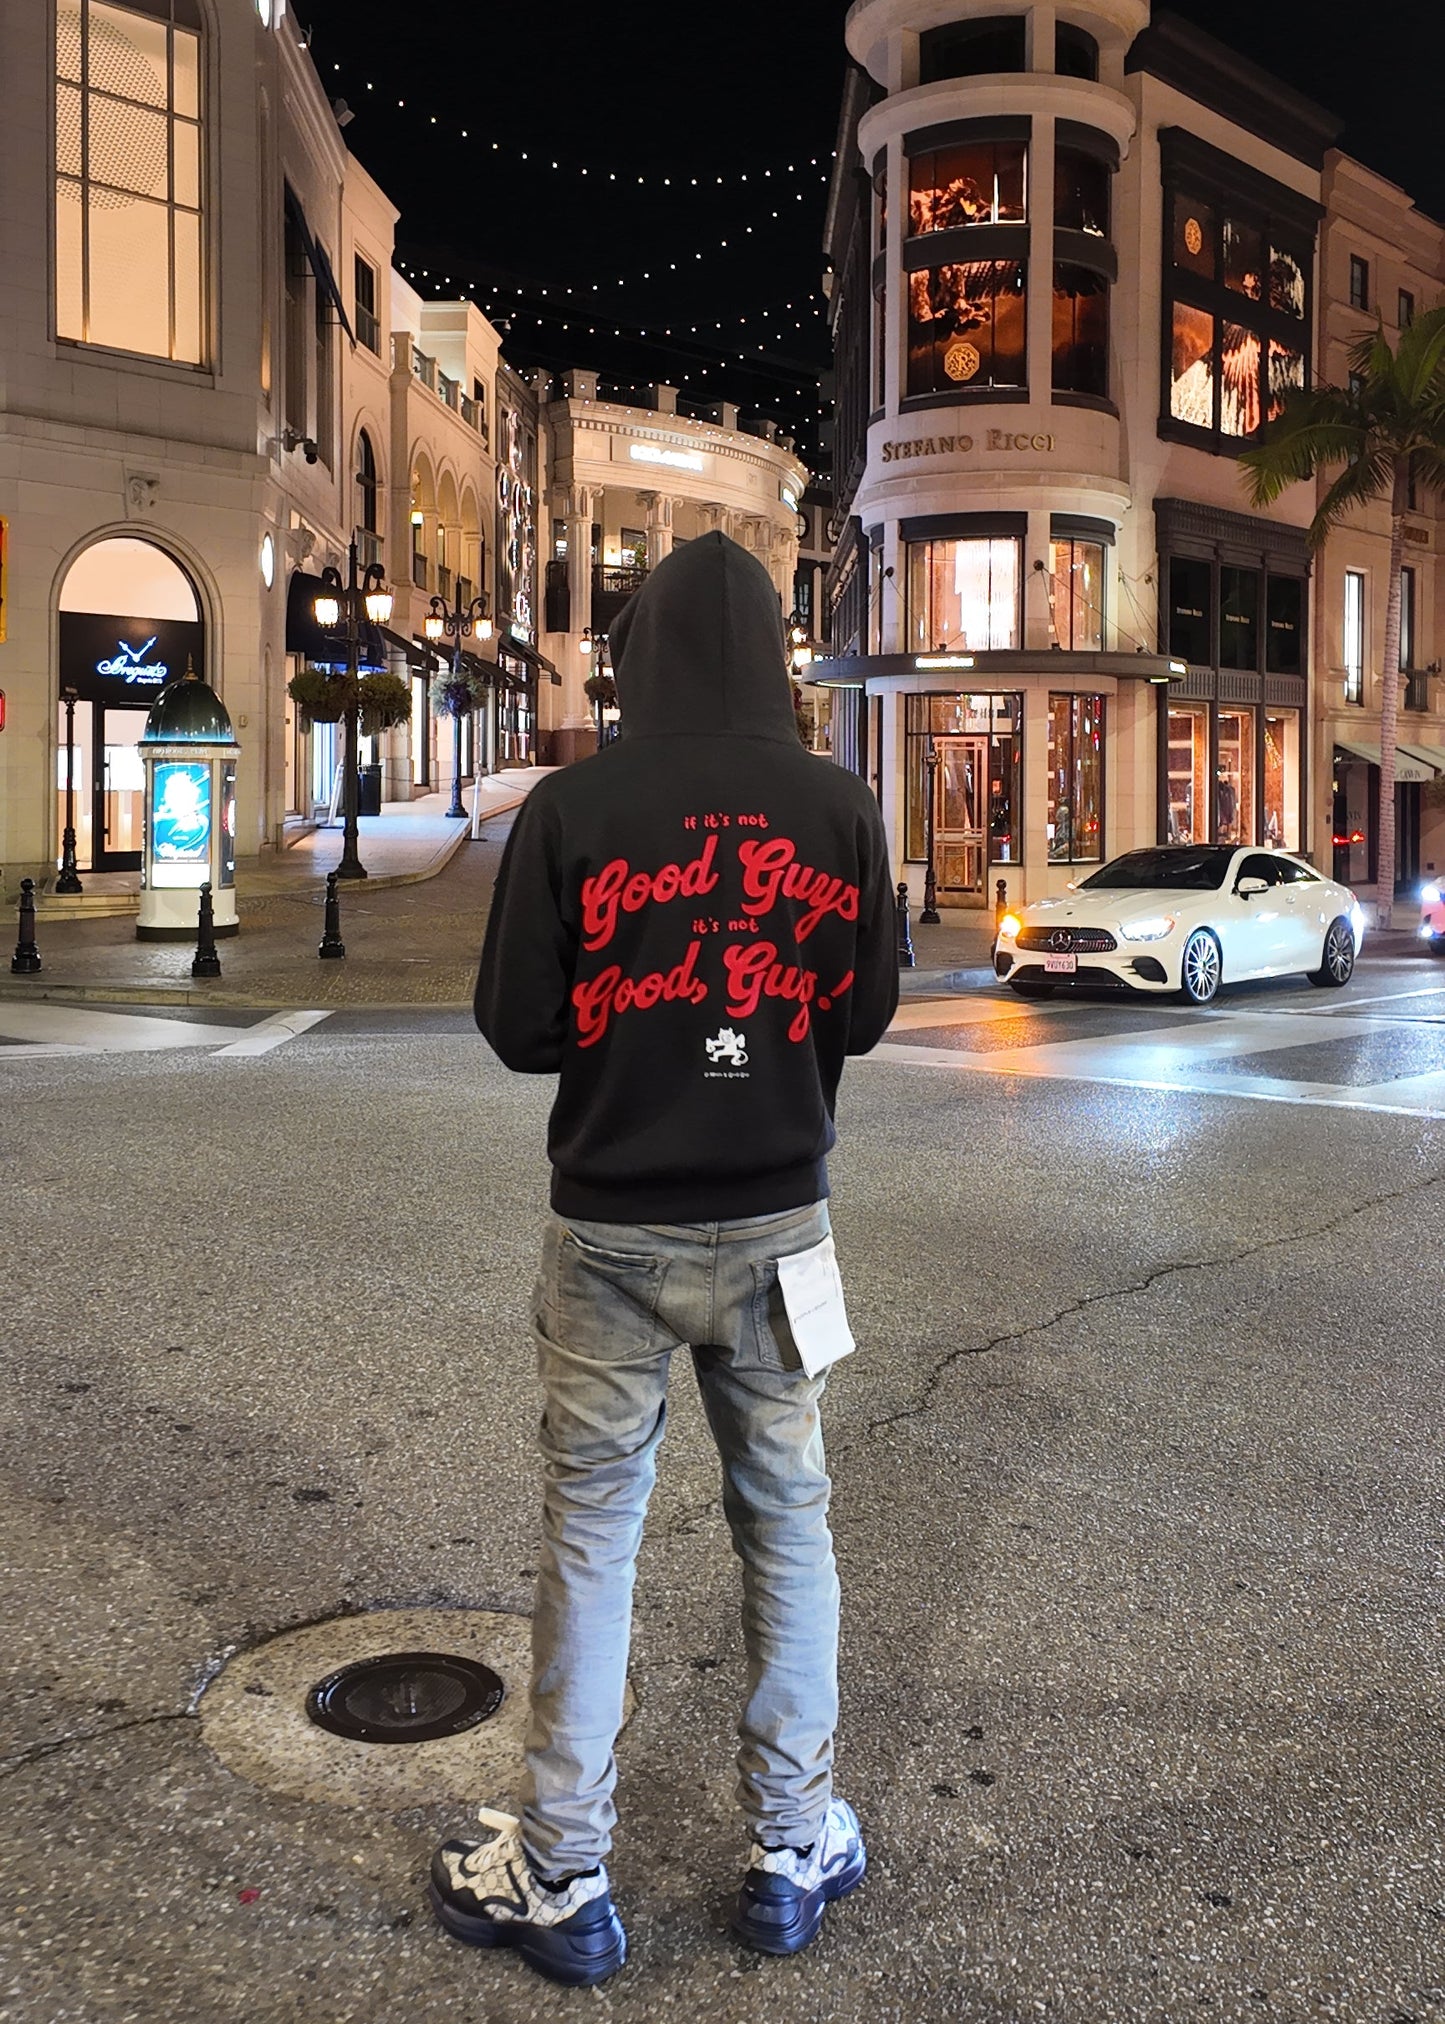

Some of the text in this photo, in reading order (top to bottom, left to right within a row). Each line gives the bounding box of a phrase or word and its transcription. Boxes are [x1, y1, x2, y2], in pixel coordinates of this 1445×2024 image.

[684, 812, 769, 830] if it's not
[580, 833, 860, 952] Good Guys
[692, 917, 761, 935] it's not
[571, 940, 709, 1048] Good,
